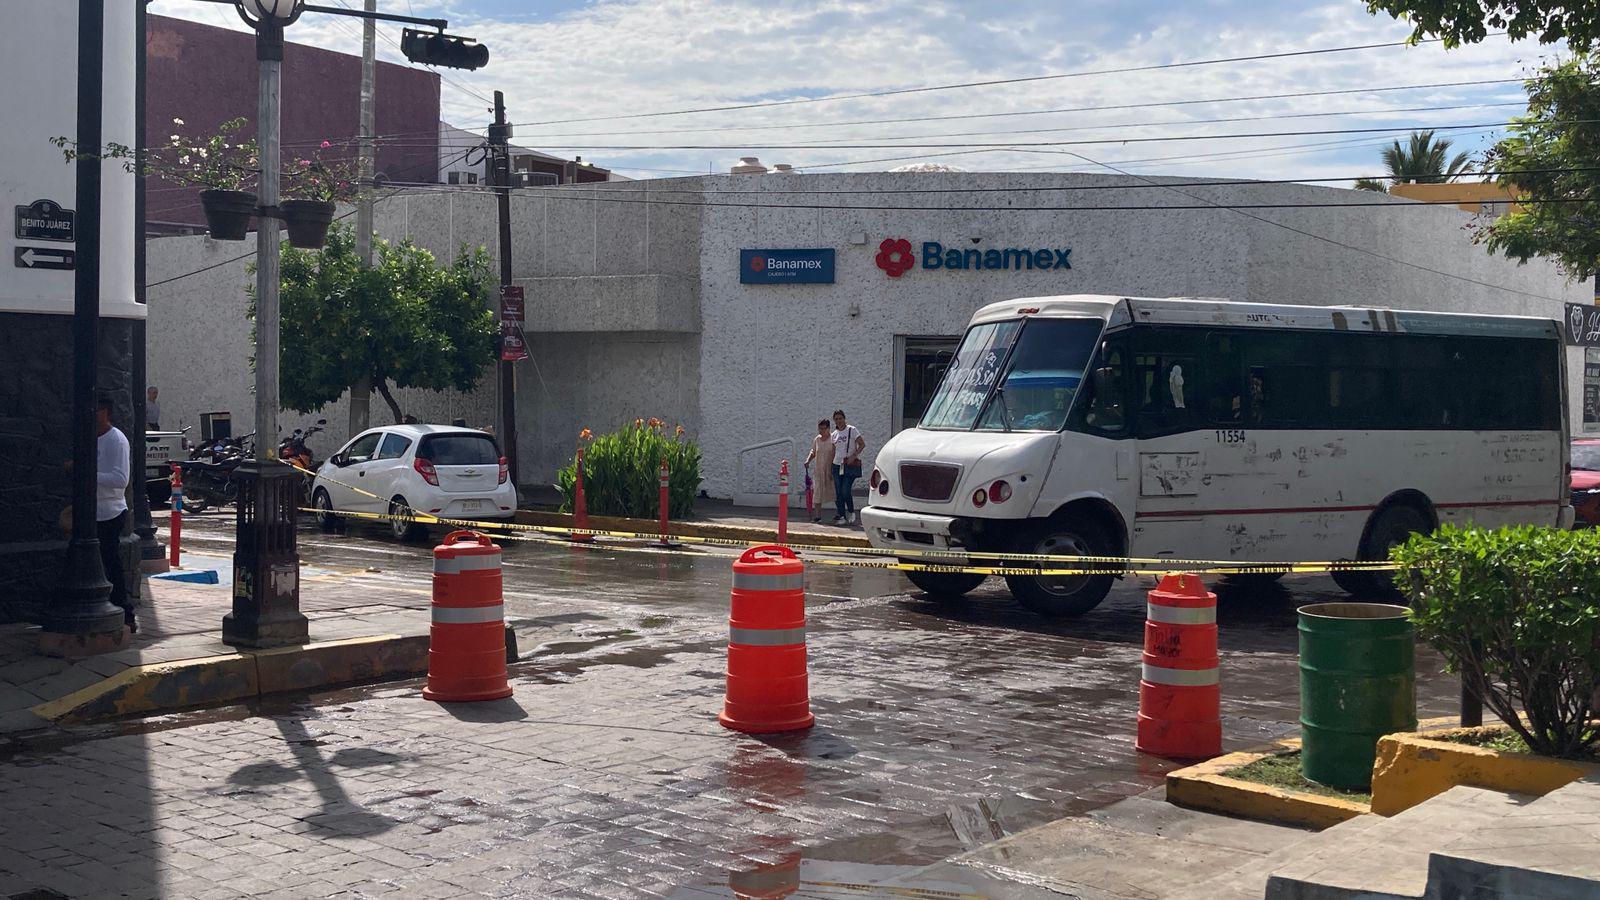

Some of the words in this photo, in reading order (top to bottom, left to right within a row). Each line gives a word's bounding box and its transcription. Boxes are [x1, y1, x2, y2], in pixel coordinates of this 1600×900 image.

[21, 218, 46, 228] BENITO
[922, 241, 1072, 270] Banamex
[767, 258, 822, 269] Banamex
[1216, 430, 1246, 443] 11554
